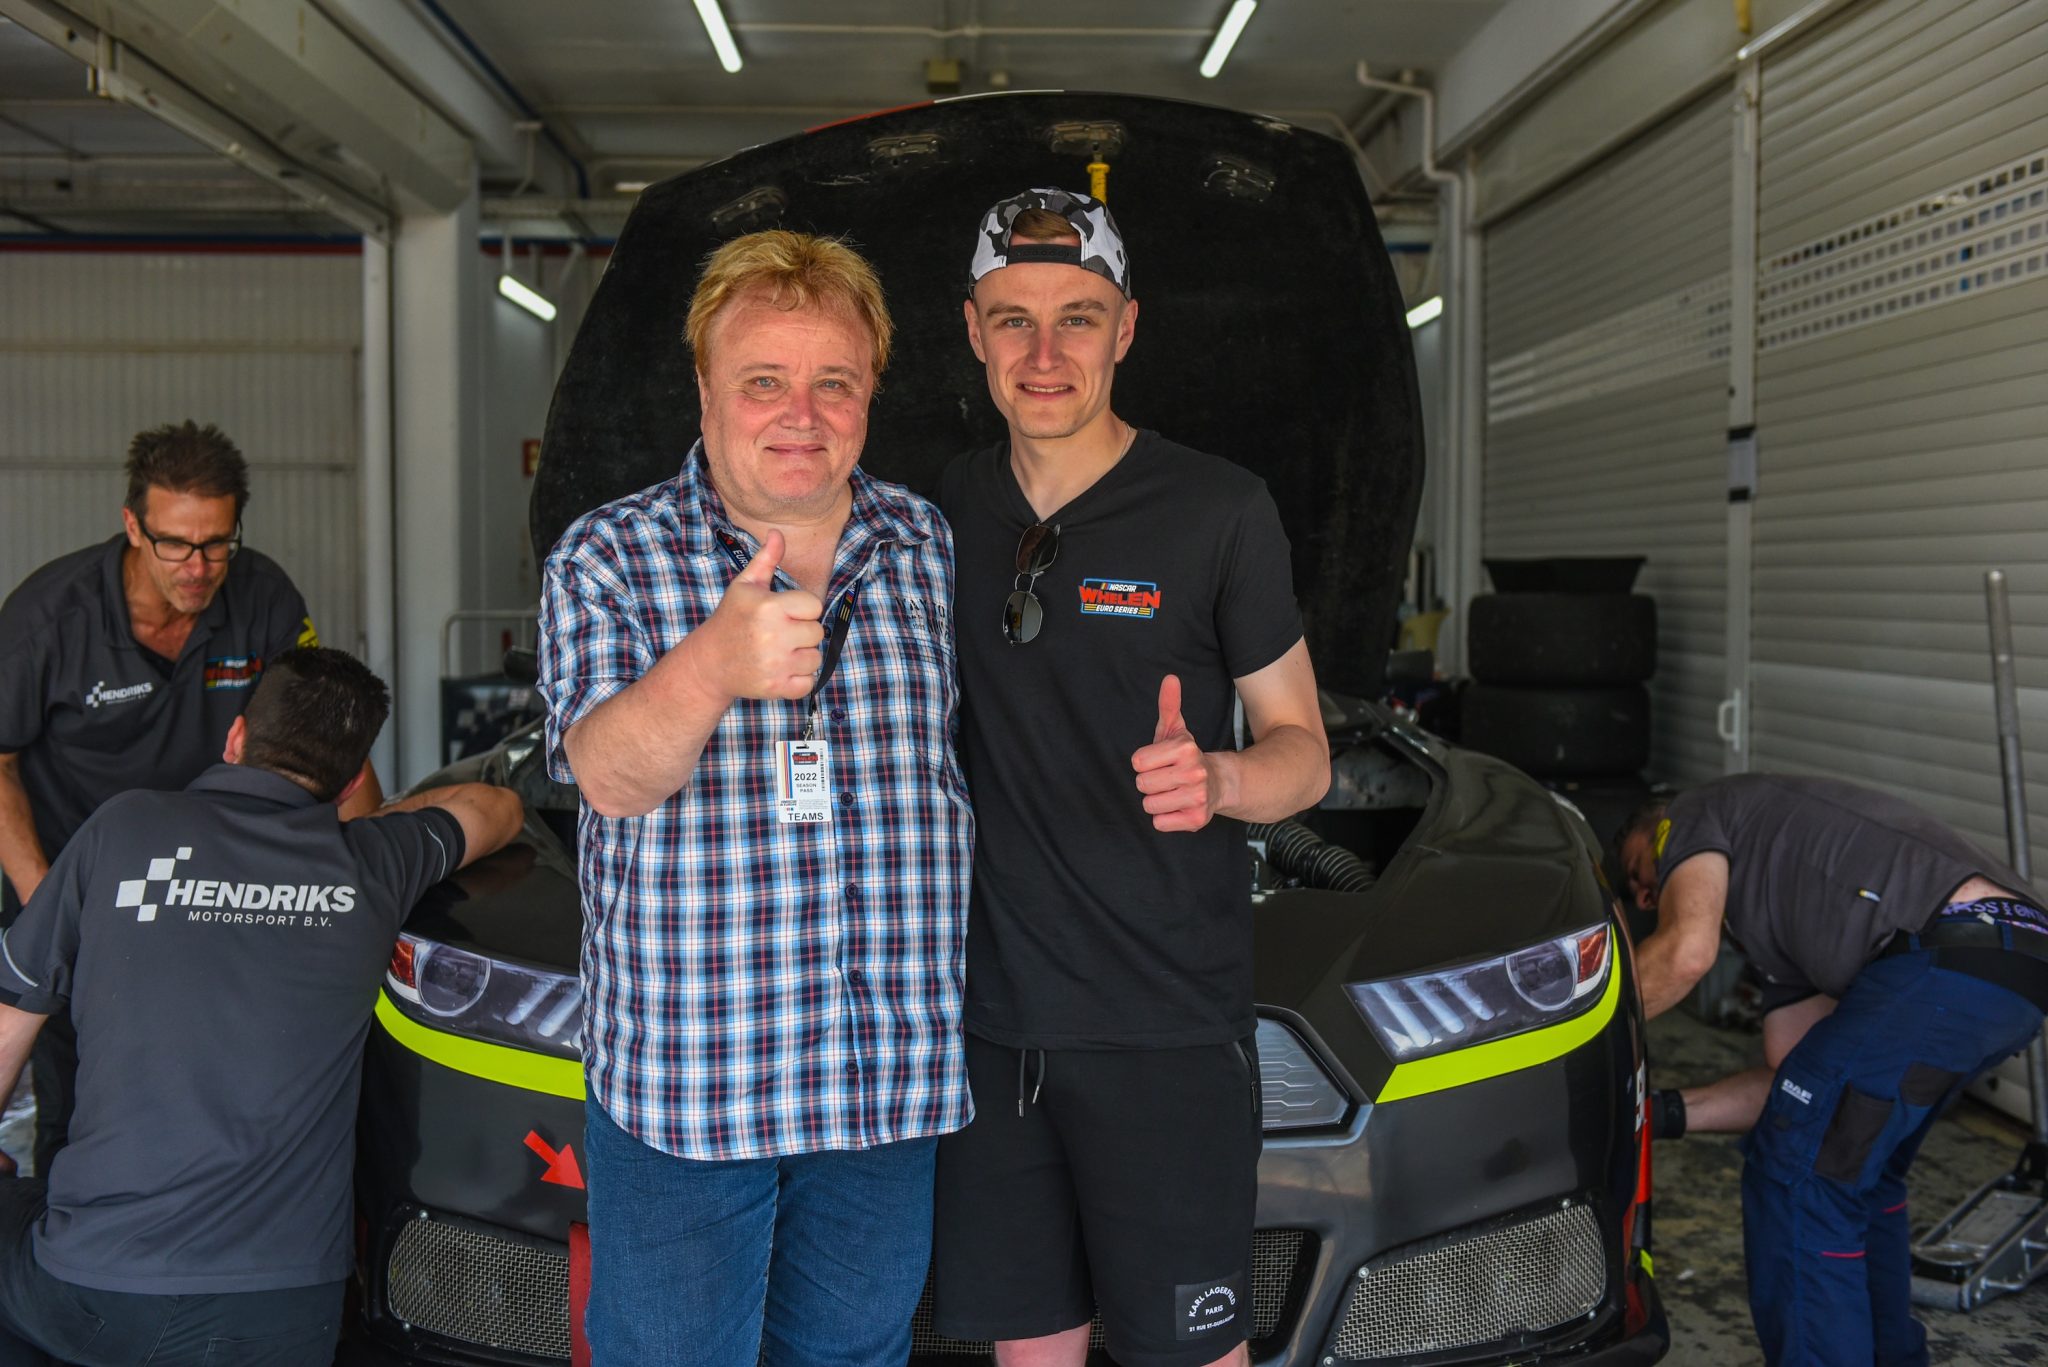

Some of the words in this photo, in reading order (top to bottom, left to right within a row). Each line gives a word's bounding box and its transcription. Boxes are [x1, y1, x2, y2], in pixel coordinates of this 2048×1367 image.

[732, 549, 750, 568] EUR
[1108, 583, 1137, 592] NASCAR
[1079, 585, 1161, 609] WHELEN
[1095, 604, 1113, 613] EURO
[1114, 605, 1139, 615] SERIES
[98, 682, 153, 701] HENDRIKS
[794, 772, 818, 781] 2022
[788, 812, 824, 821] TEAMS
[165, 878, 357, 913] HENDRIKS
[187, 911, 297, 926] MOTORSPORT
[303, 915, 333, 928] B.V.
[1188, 1296, 1205, 1318] KARL
[1204, 1286, 1236, 1305] LAGERFELD
[1205, 1304, 1224, 1316] PARIS
